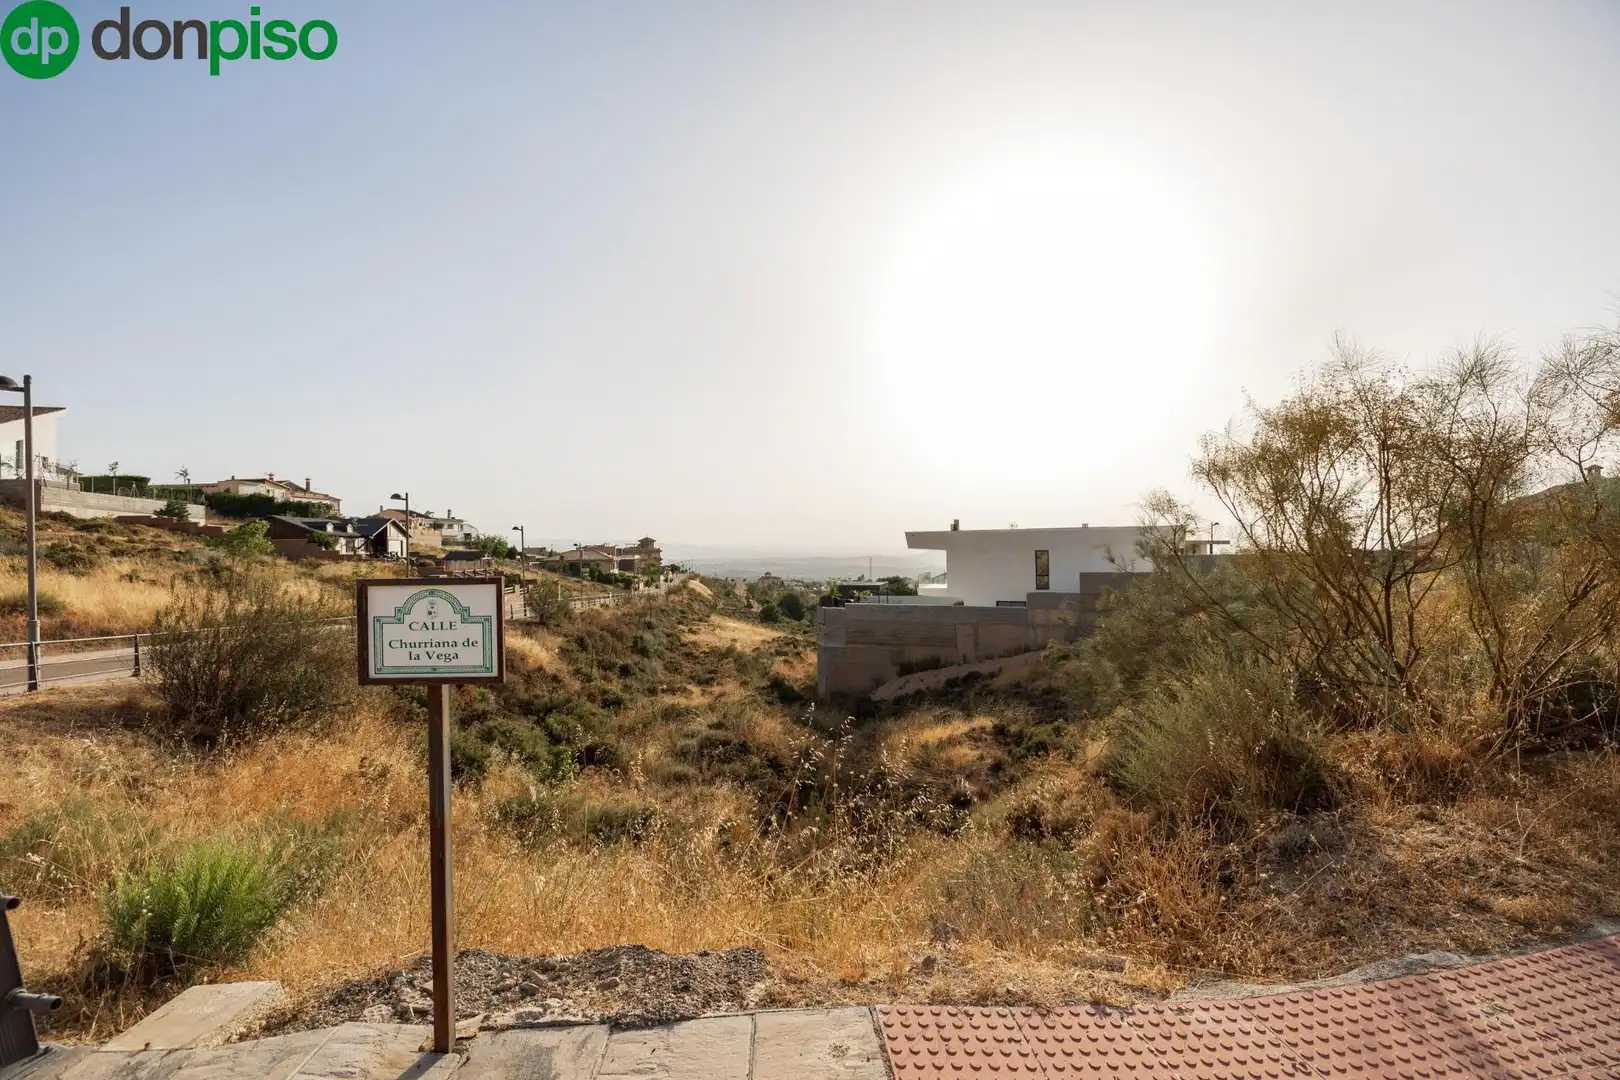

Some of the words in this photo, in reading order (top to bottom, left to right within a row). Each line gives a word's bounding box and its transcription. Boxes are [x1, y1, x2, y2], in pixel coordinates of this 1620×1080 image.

[409, 621, 458, 631] CALLE
[388, 639, 458, 649] Churriana
[462, 638, 479, 648] de
[408, 651, 420, 661] la
[425, 651, 459, 663] Vega
